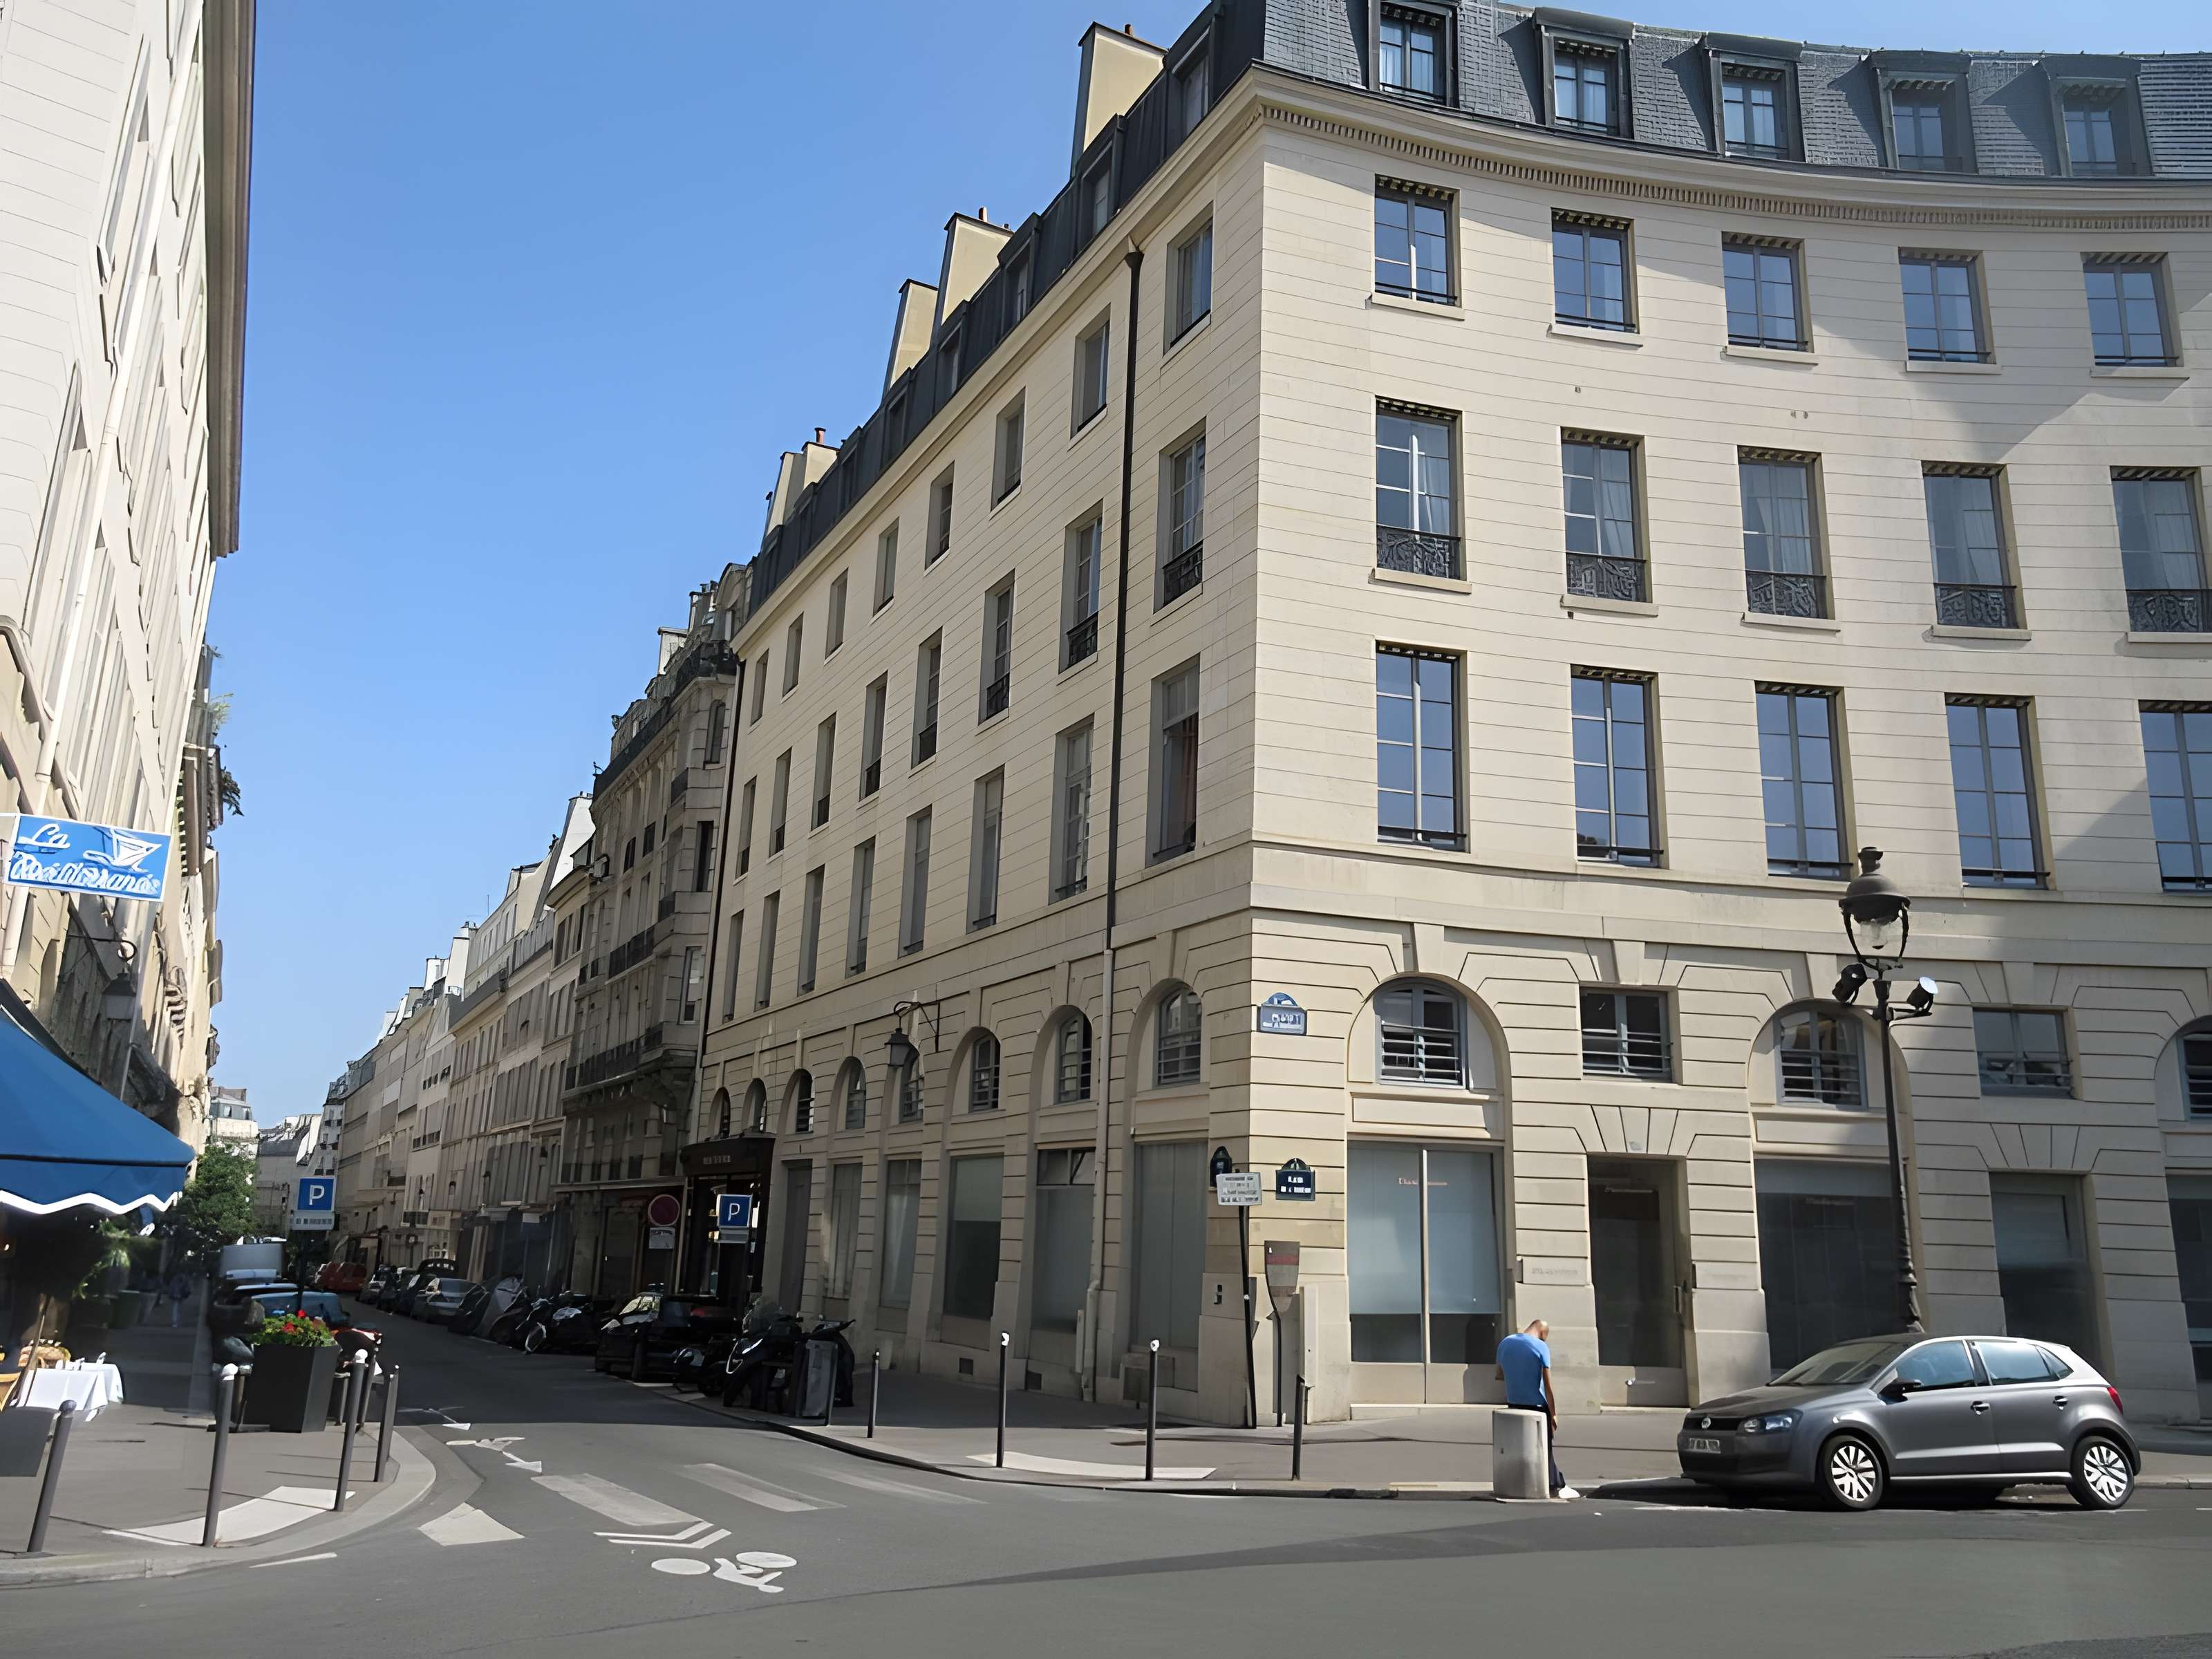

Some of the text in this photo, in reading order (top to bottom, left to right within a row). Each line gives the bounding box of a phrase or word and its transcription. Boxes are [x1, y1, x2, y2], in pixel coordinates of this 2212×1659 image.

[16, 823, 71, 849] La
[309, 1184, 325, 1206] P
[728, 1203, 740, 1221] P
